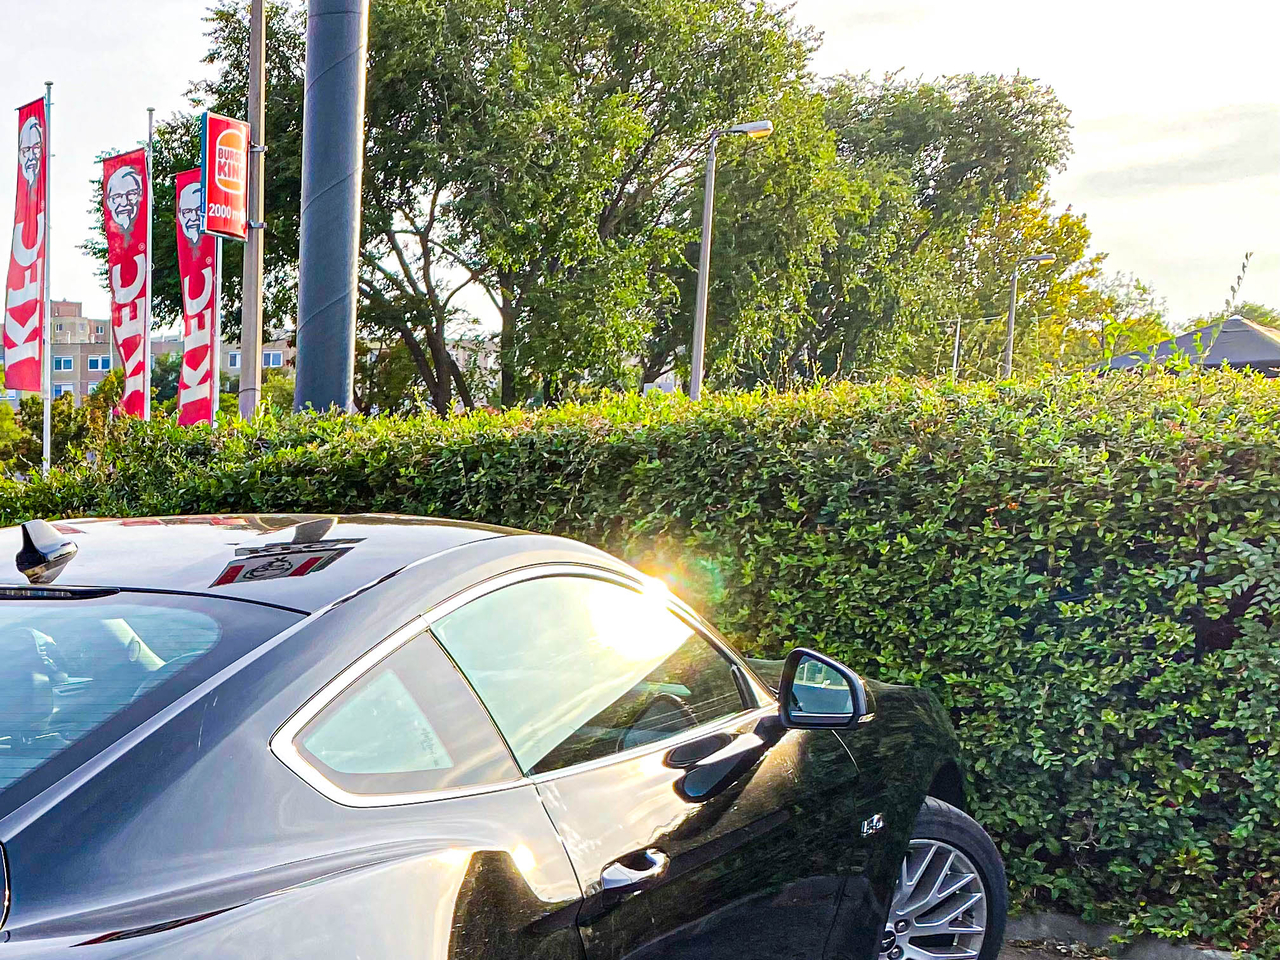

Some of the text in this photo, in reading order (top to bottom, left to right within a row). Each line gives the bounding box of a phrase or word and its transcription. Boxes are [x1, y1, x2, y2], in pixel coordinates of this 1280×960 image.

[208, 202, 232, 219] 2000
[218, 147, 245, 165] BURGE
[4, 211, 45, 371] KFC
[111, 253, 146, 401] KFC
[179, 266, 213, 409] KFC
